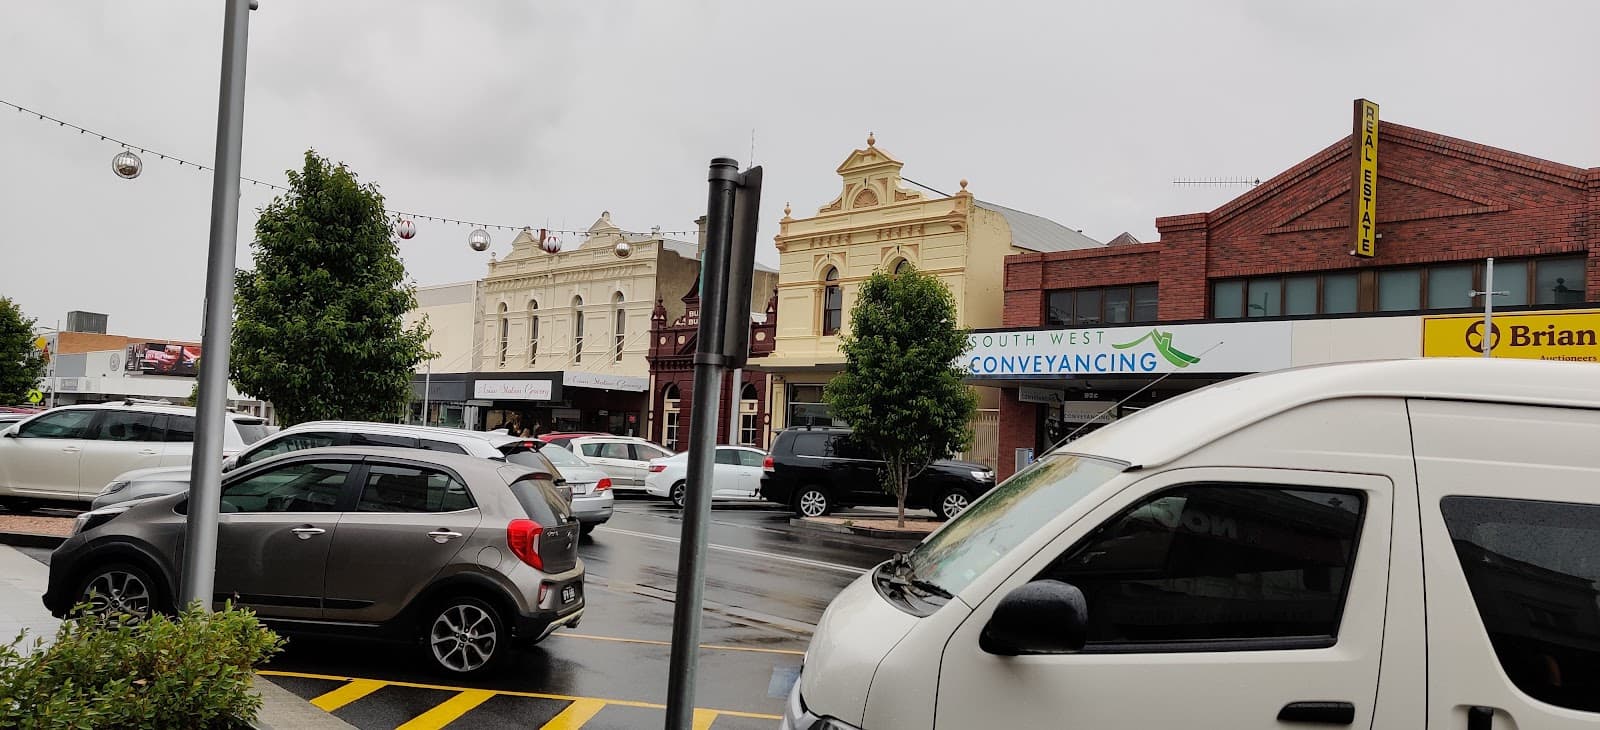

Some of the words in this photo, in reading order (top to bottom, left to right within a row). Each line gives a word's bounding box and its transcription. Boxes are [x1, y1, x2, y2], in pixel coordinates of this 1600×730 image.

[1364, 105, 1375, 162] REAL
[1361, 169, 1373, 252] ESTATE
[970, 333, 1036, 348] SOUTH
[1050, 330, 1105, 345] WEST
[1510, 324, 1597, 347] Brian
[970, 352, 1157, 373] CONVEYANCING
